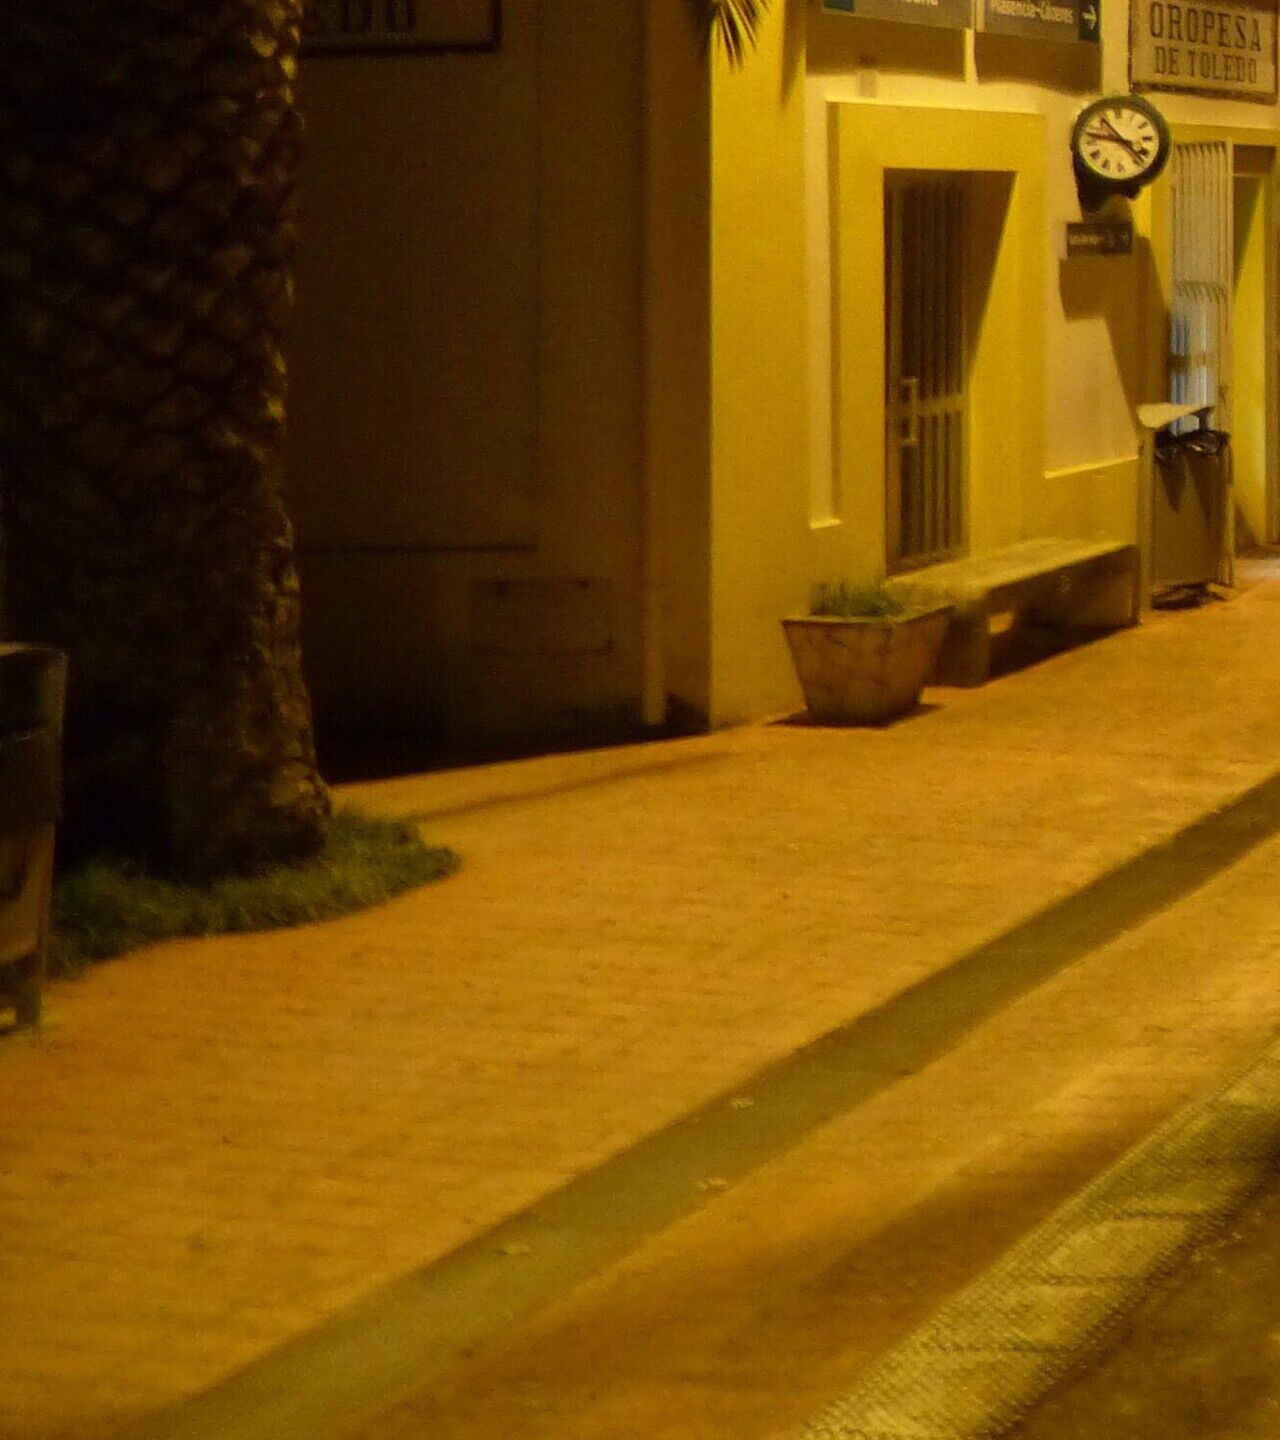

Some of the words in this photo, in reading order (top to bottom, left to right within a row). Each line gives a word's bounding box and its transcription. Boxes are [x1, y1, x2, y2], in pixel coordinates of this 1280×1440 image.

[1150, 1, 1261, 52] OROPESA
[1154, 45, 1180, 76] DE
[1187, 49, 1258, 84] TOLEDO
